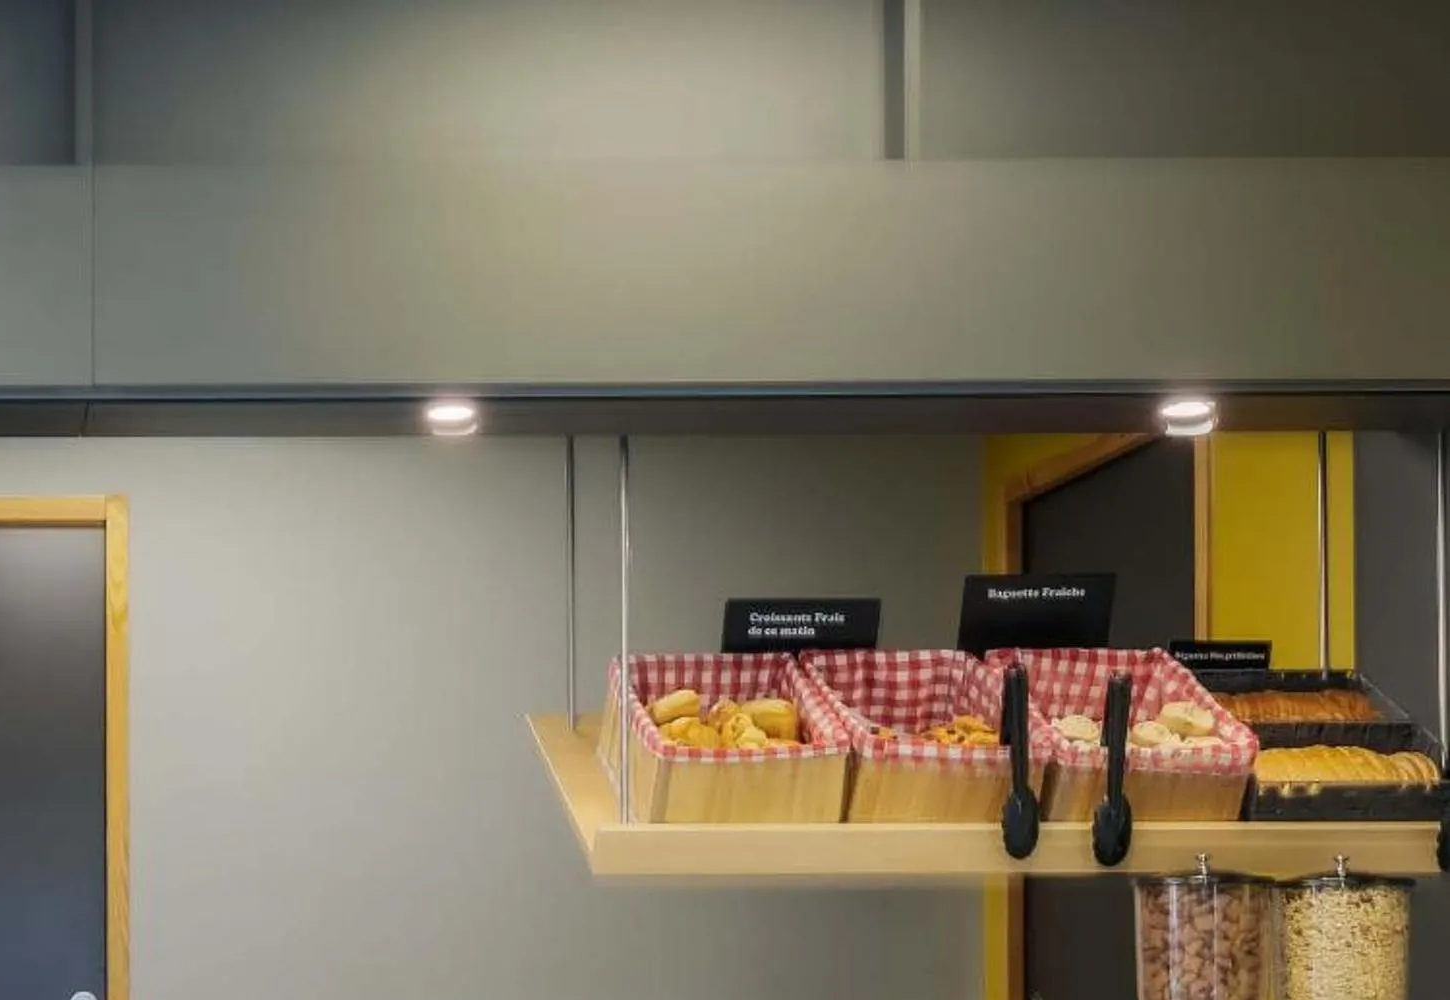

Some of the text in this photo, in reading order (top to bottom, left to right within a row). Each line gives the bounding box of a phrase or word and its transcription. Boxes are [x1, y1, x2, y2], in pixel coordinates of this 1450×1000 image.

[987, 588, 1039, 600] Baguette
[749, 611, 845, 623] Croissants Frais
[747, 626, 815, 636] de ce matin
